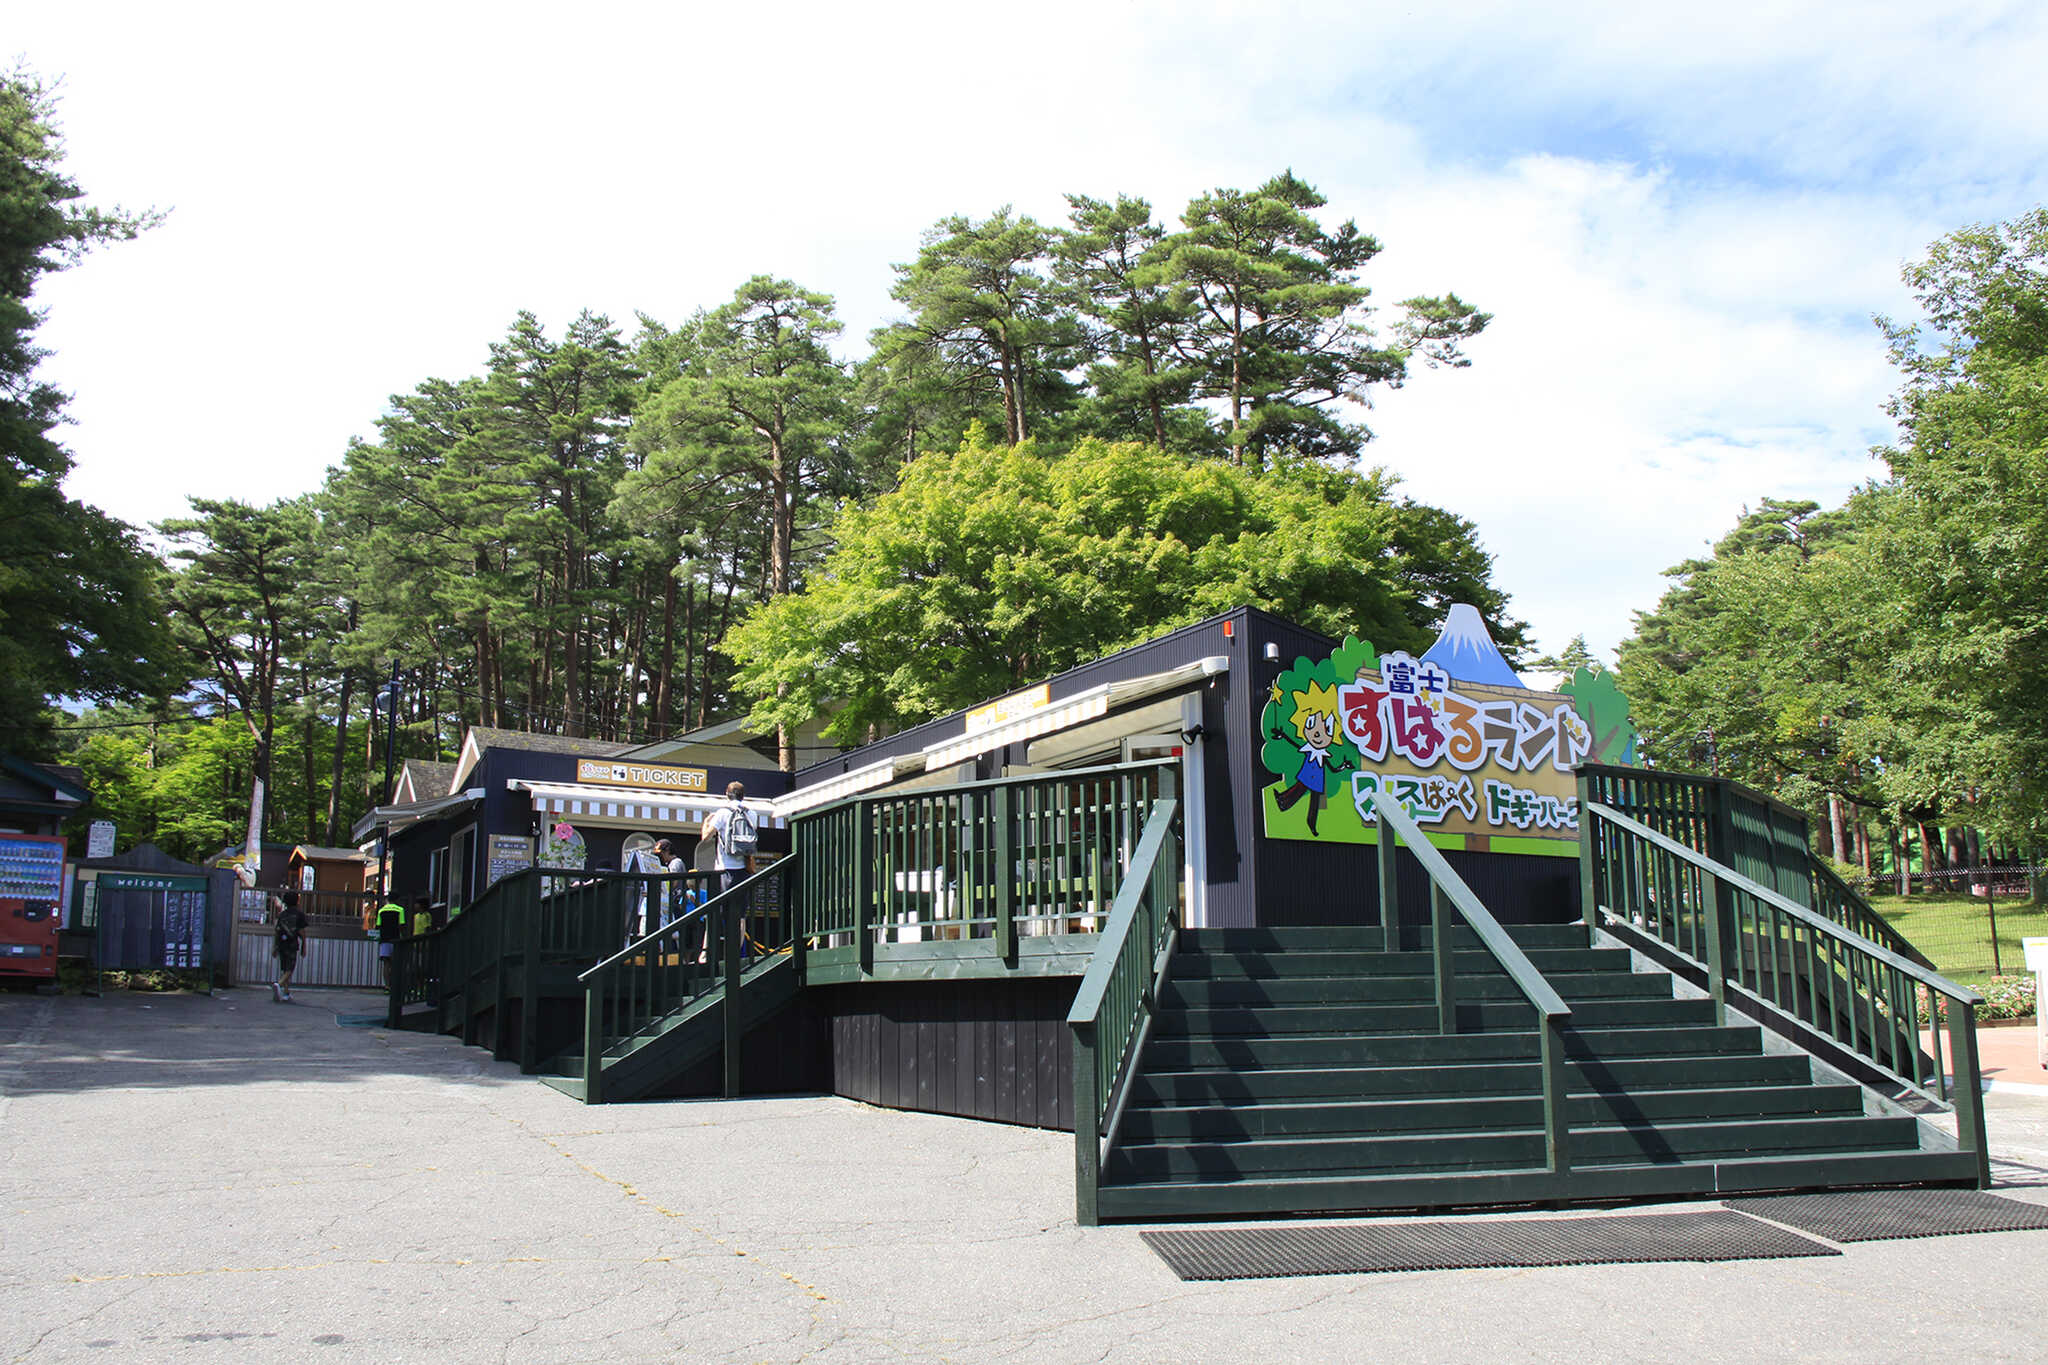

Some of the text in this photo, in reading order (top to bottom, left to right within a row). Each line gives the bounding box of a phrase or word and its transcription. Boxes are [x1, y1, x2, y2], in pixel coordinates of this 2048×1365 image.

[1385, 662, 1445, 695] 富士
[1342, 686, 1587, 766] すばるランド
[630, 767, 705, 787] TICKET
[117, 878, 173, 888] welcome
